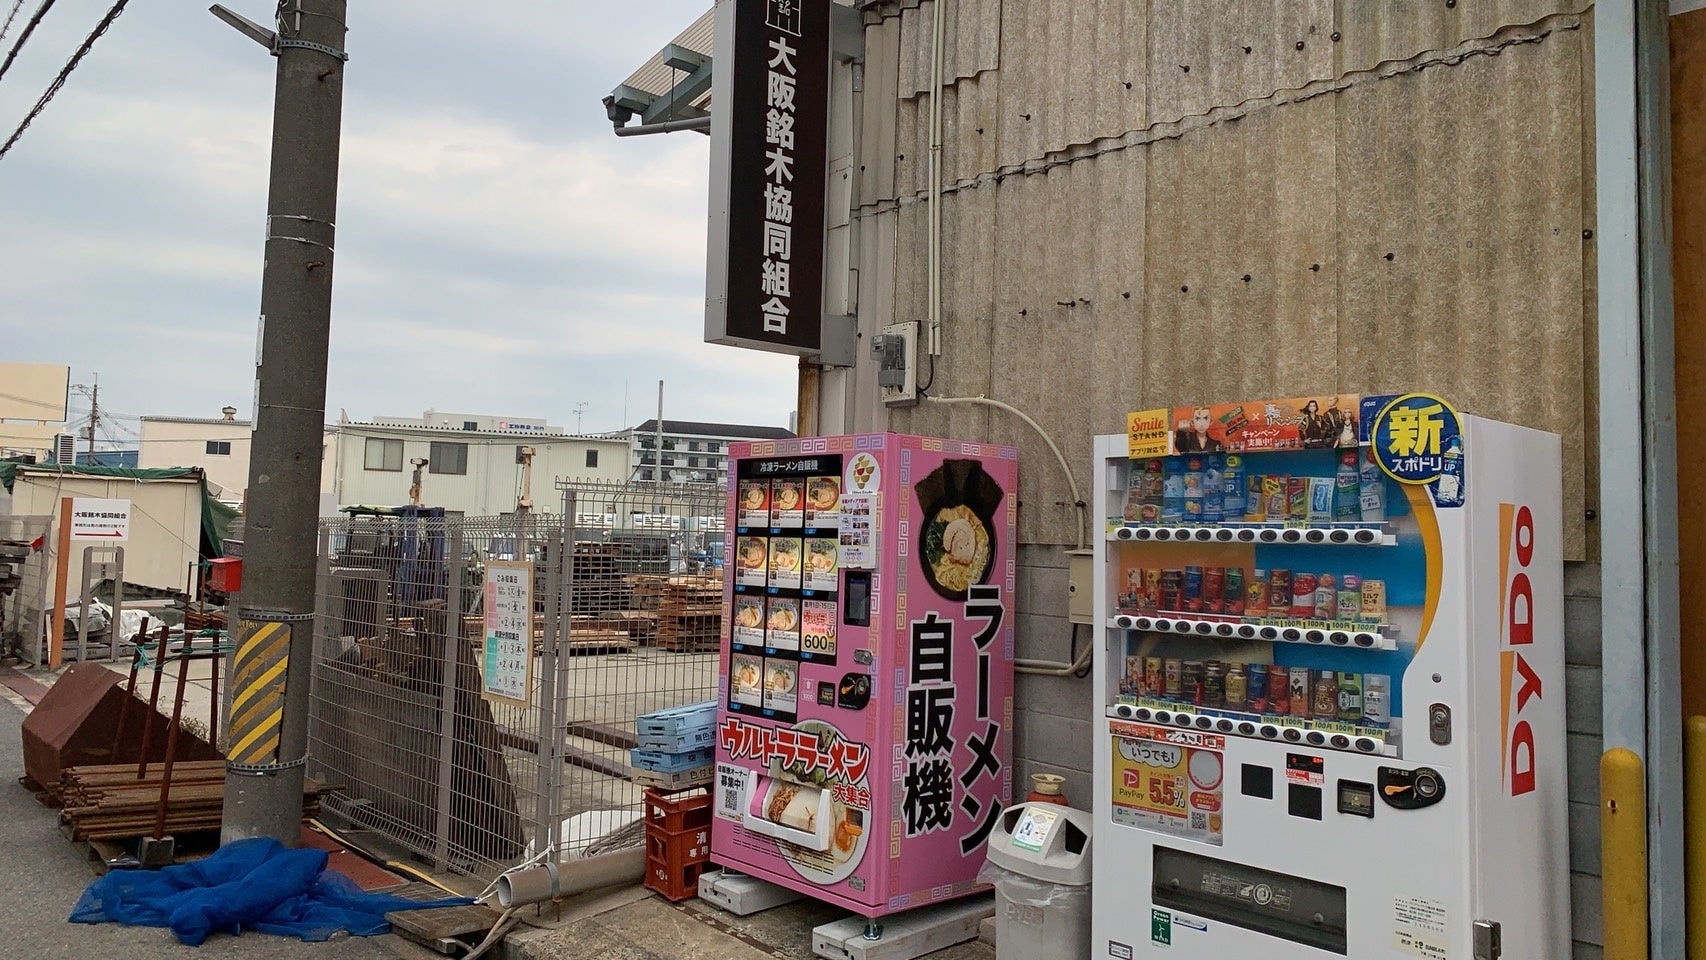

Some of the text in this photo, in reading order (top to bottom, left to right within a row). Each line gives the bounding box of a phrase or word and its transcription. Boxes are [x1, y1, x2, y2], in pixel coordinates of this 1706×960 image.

[761, 37, 797, 335] 大阪銘木協同組合
[1131, 417, 1164, 432] Smile
[1388, 403, 1444, 457] 新
[1133, 431, 1166, 440] STAND
[1242, 429, 1280, 439] キャンペーン
[760, 460, 818, 472] 冷凍ラーメン自販機
[1392, 457, 1441, 472] スポドリ
[804, 633, 835, 651] 600円
[904, 613, 955, 836] 自販機
[961, 585, 1005, 859] ラーメン
[1285, 717, 1303, 725] 100円
[1315, 721, 1332, 729] 100円
[1335, 724, 1353, 732] 100円
[719, 716, 871, 784] ウルトララーメン
[1131, 748, 1174, 764] いつでも!
[833, 783, 871, 810] 大集合
[1119, 788, 1145, 800] PayPay
[1153, 910, 1169, 919] Green
[1153, 915, 1170, 923] Power
